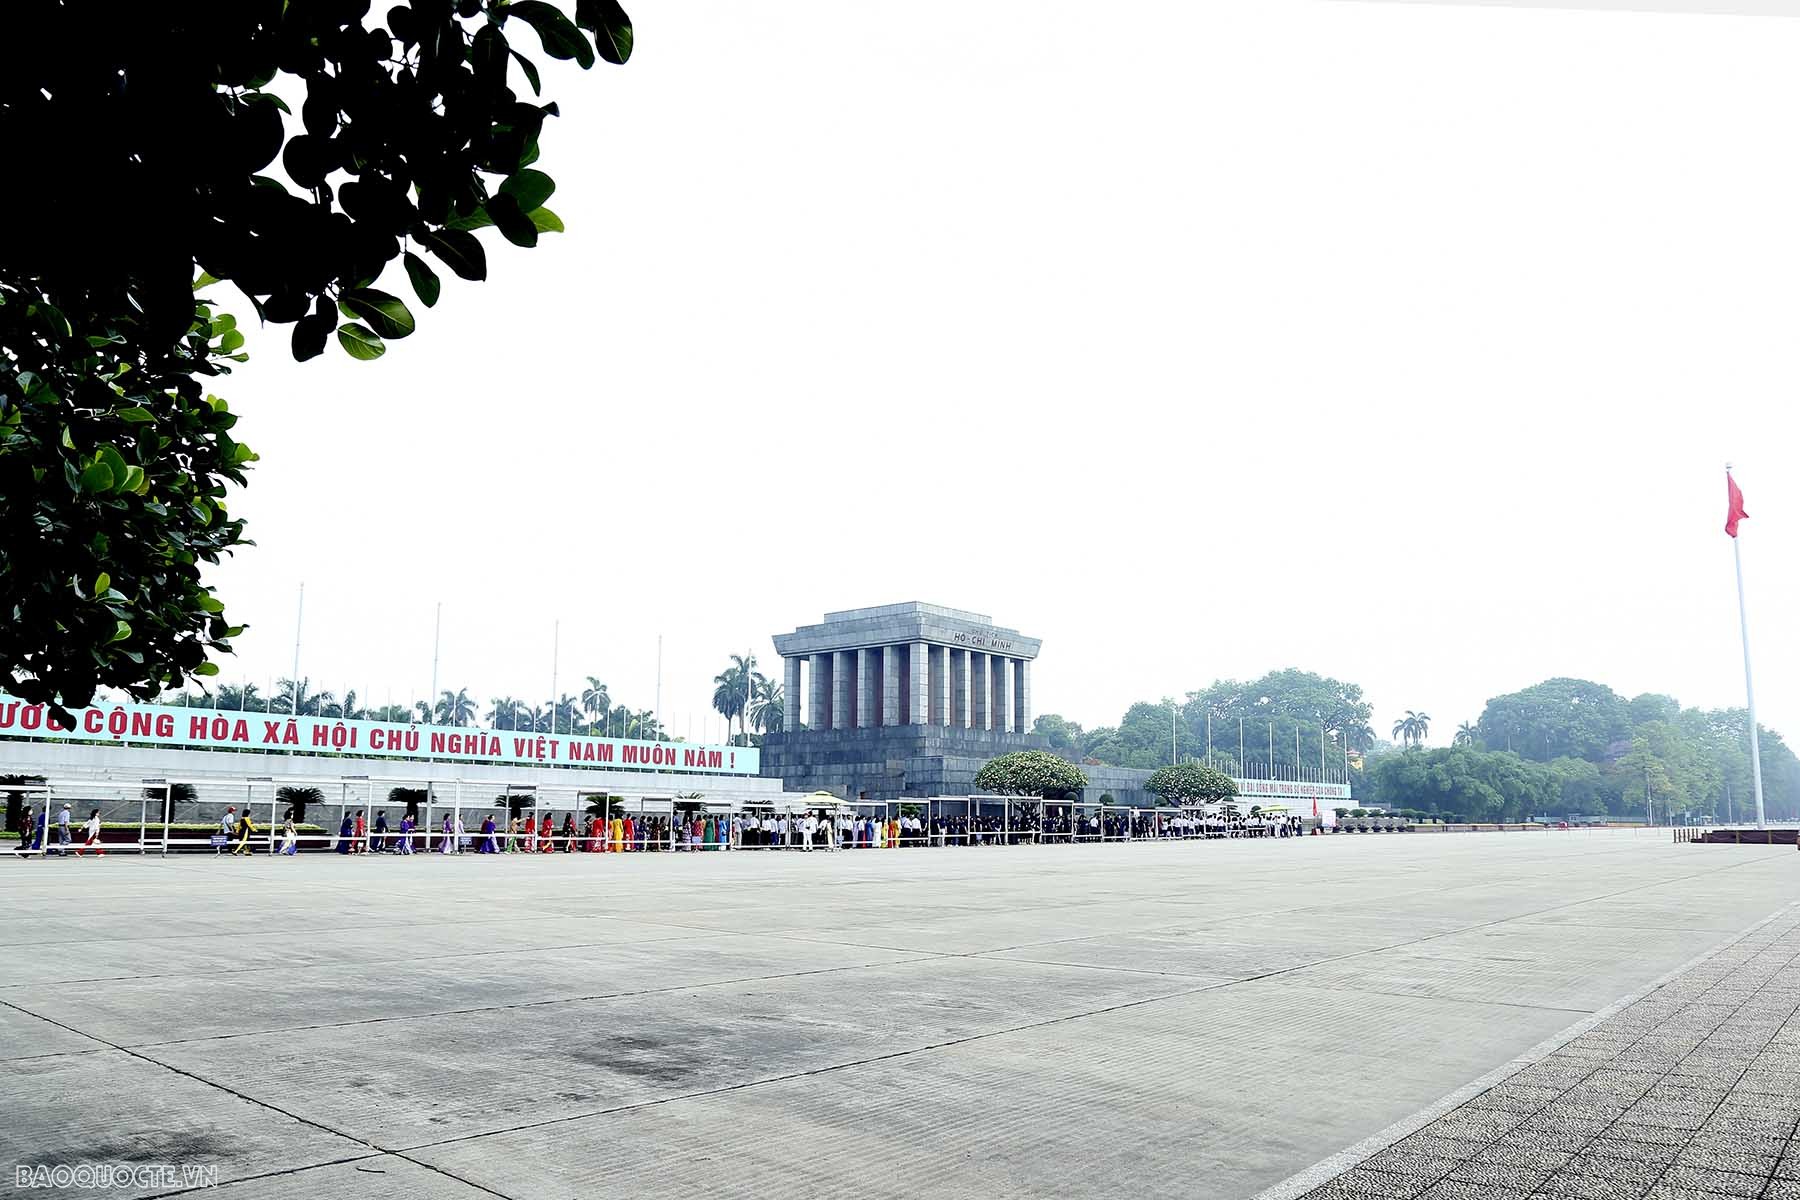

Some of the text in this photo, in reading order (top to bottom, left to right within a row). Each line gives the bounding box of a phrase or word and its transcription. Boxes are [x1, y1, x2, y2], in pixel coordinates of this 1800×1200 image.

[85, 706, 174, 739] CỘNG
[190, 713, 249, 742] HÒA
[263, 718, 299, 745] XÃ
[313, 721, 357, 751] HỘI
[370, 724, 419, 752] CHỦ
[431, 731, 502, 756] NGHĨA
[514, 736, 559, 762] VIỆT
[569, 742, 613, 762] NAM
[622, 743, 676, 766] MUÔN
[685, 747, 723, 768] NĂM
